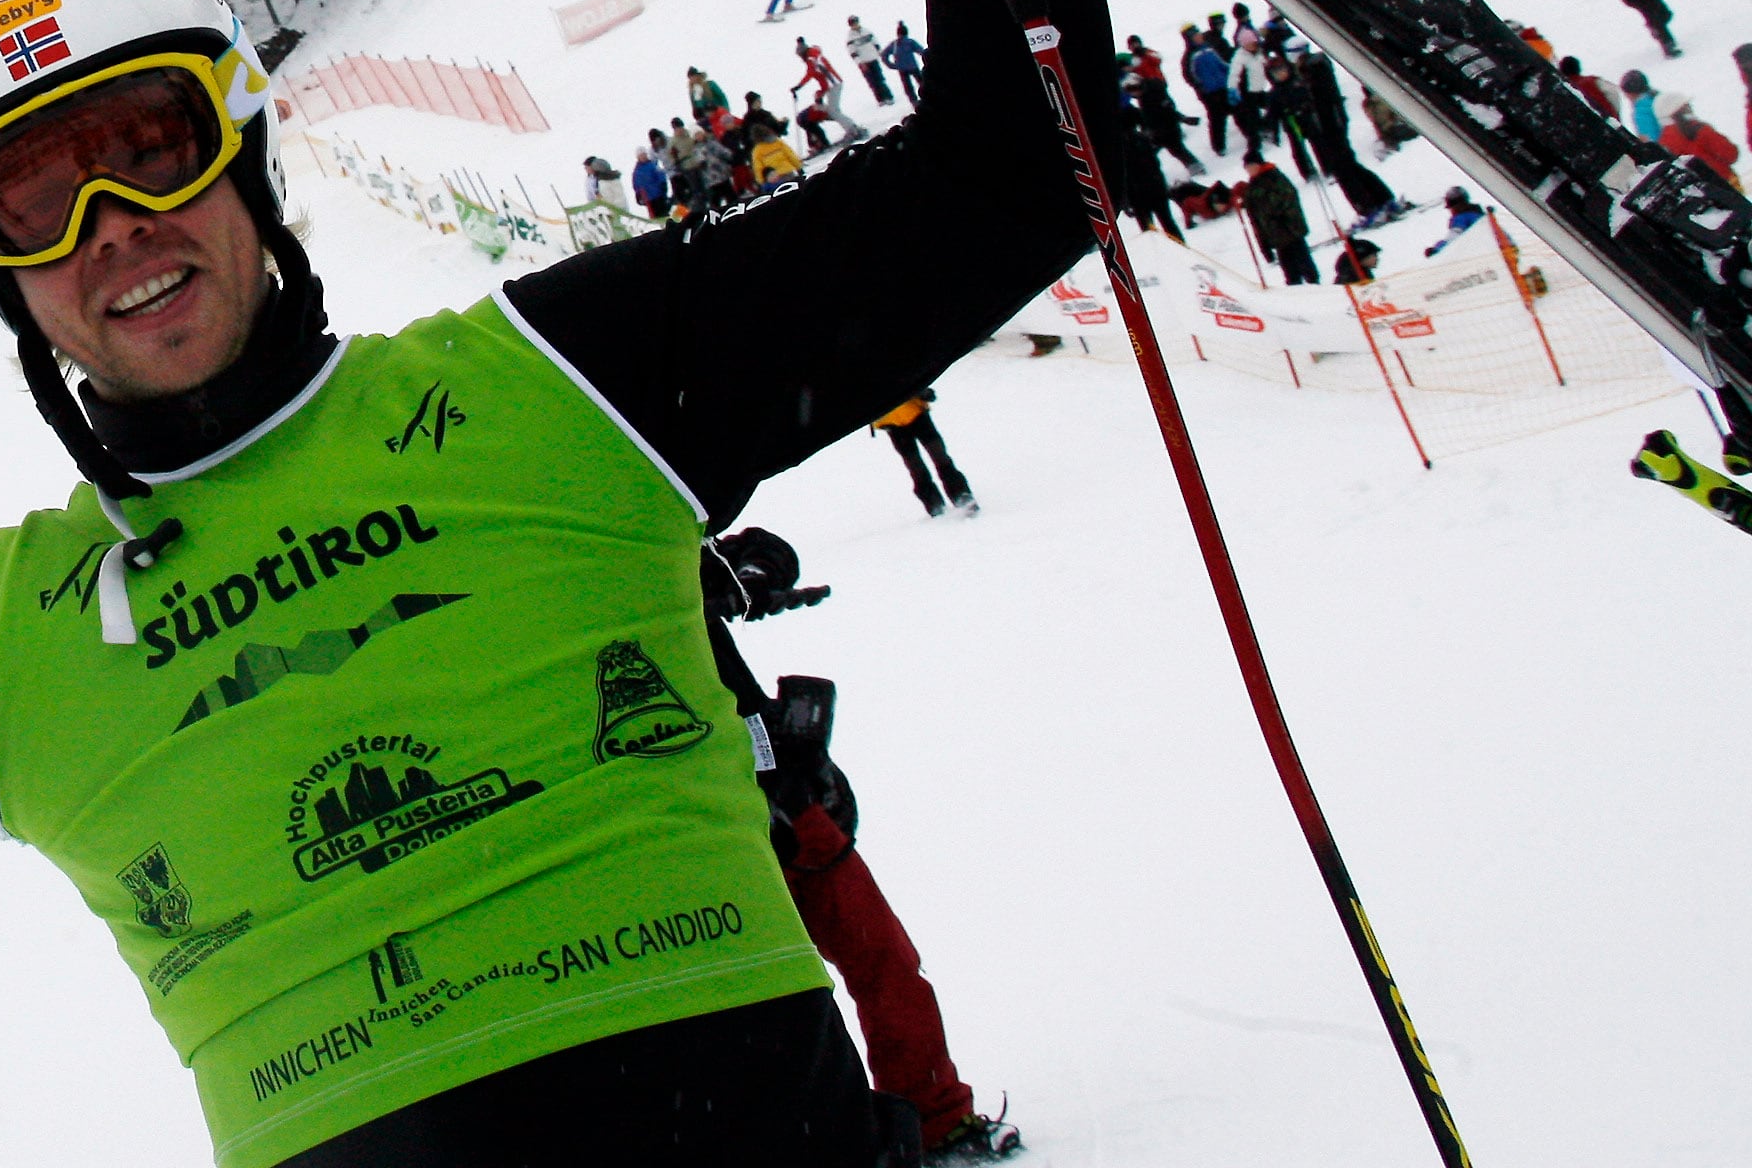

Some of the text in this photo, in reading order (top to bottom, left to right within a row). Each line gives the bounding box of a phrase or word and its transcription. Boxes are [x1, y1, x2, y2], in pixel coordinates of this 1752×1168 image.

[384, 392, 466, 454] FIS
[285, 733, 442, 844] Hochpustertal
[311, 782, 497, 872] Alta Pusteria
[536, 901, 744, 984] SAN CANDIDO
[367, 978, 452, 1024] Innichen
[410, 1001, 447, 1028] San
[446, 961, 539, 1002] Candido
[249, 1016, 374, 1102] INNICHEN
